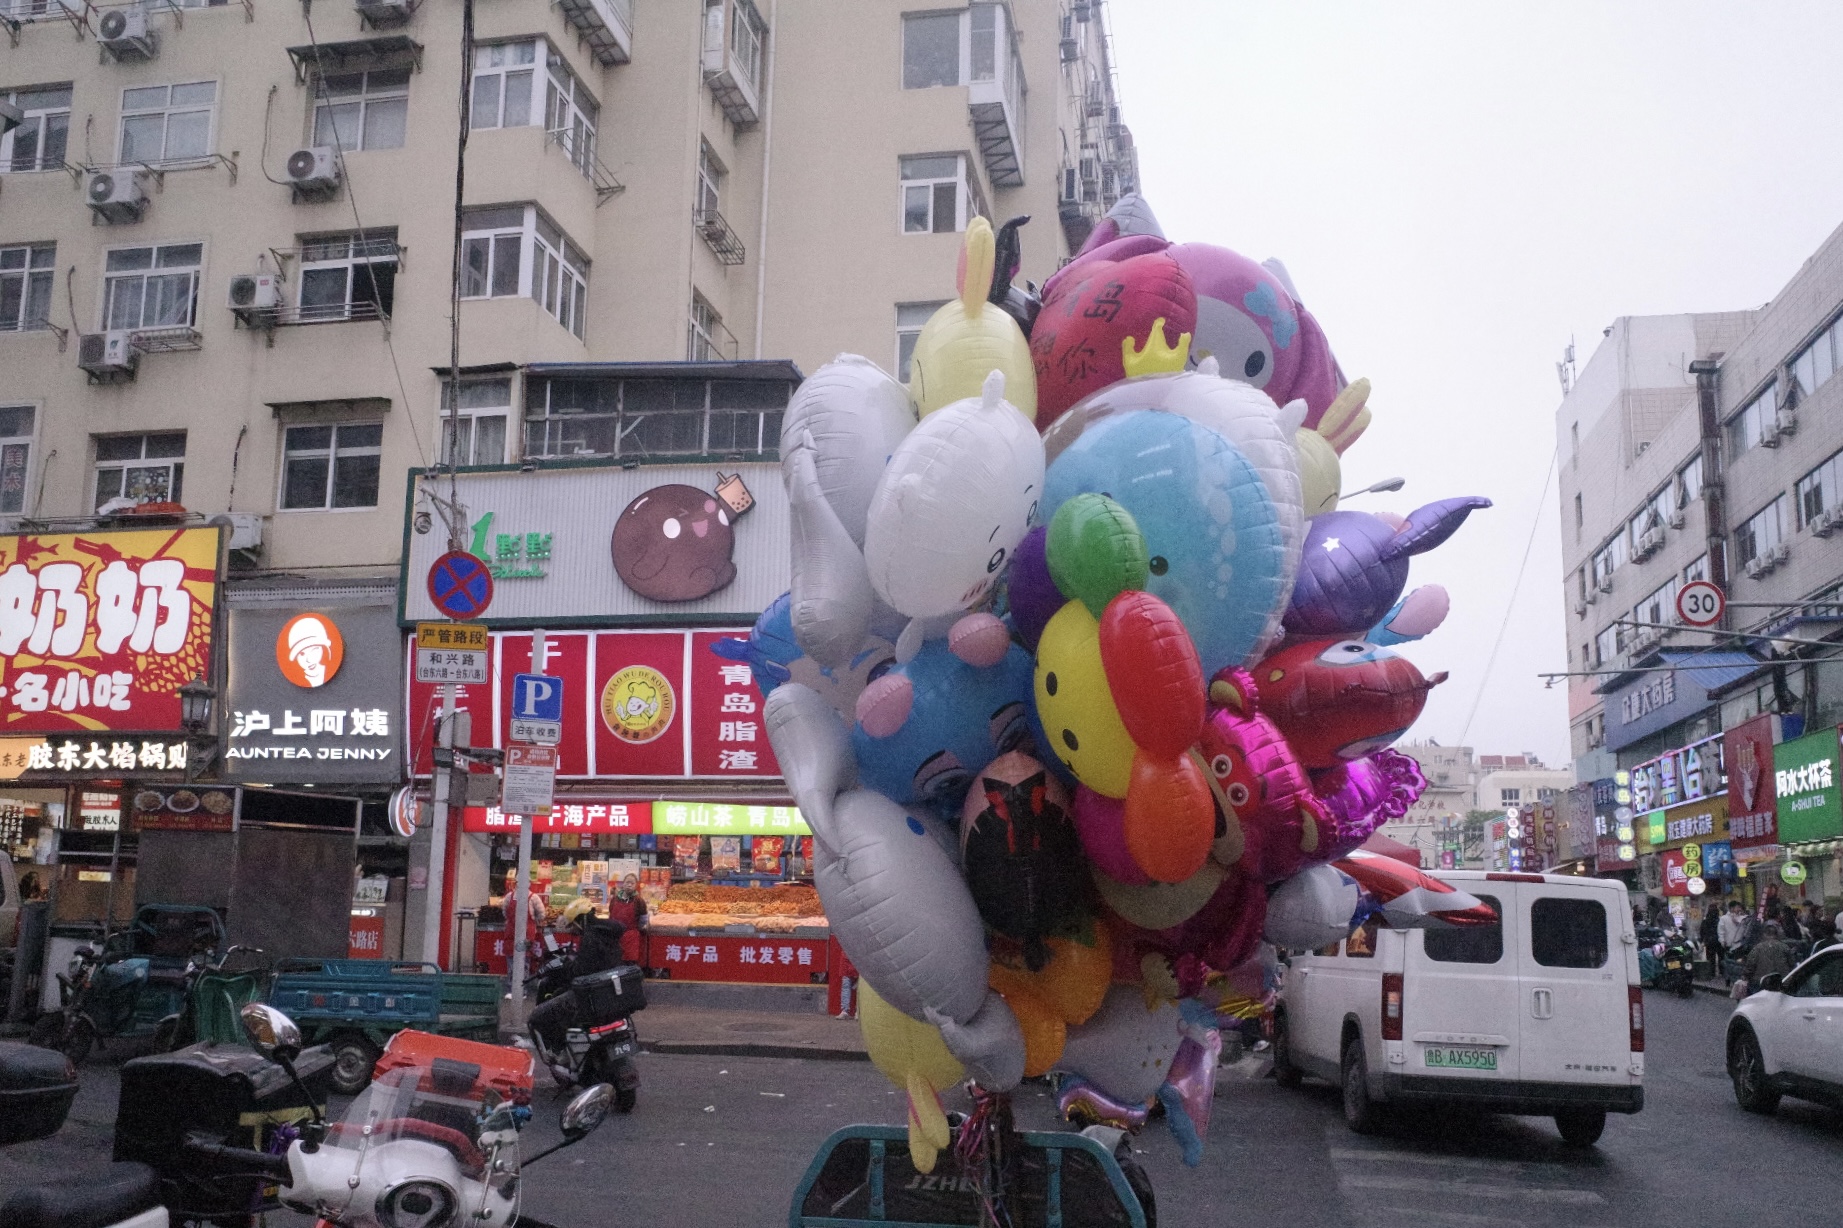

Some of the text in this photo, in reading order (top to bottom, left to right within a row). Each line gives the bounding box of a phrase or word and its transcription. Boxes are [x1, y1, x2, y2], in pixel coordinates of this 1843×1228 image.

[1688, 593, 1715, 613] 30
[422, 628, 483, 645] 严管路段
[430, 653, 475, 667] 和兴路
[0, 671, 133, 711] 名小吃
[521, 680, 553, 716] P
[718, 637, 759, 769] 青岛脂渣
[230, 708, 389, 737] 沪上阿姨
[515, 725, 557, 738] 泊车收费
[225, 746, 391, 760] AUNTEA JENNY
[510, 749, 522, 765] P
[1775, 758, 1833, 798] 阿水大杯茶
[1813, 794, 1826, 807] TEA
[548, 804, 630, 826] 干海产品
[665, 805, 733, 827] 崂山茶
[1615, 771, 1634, 859] 青岛酒店
[1685, 845, 1699, 875] 药房
[665, 944, 813, 966] 海产品 批发零售
